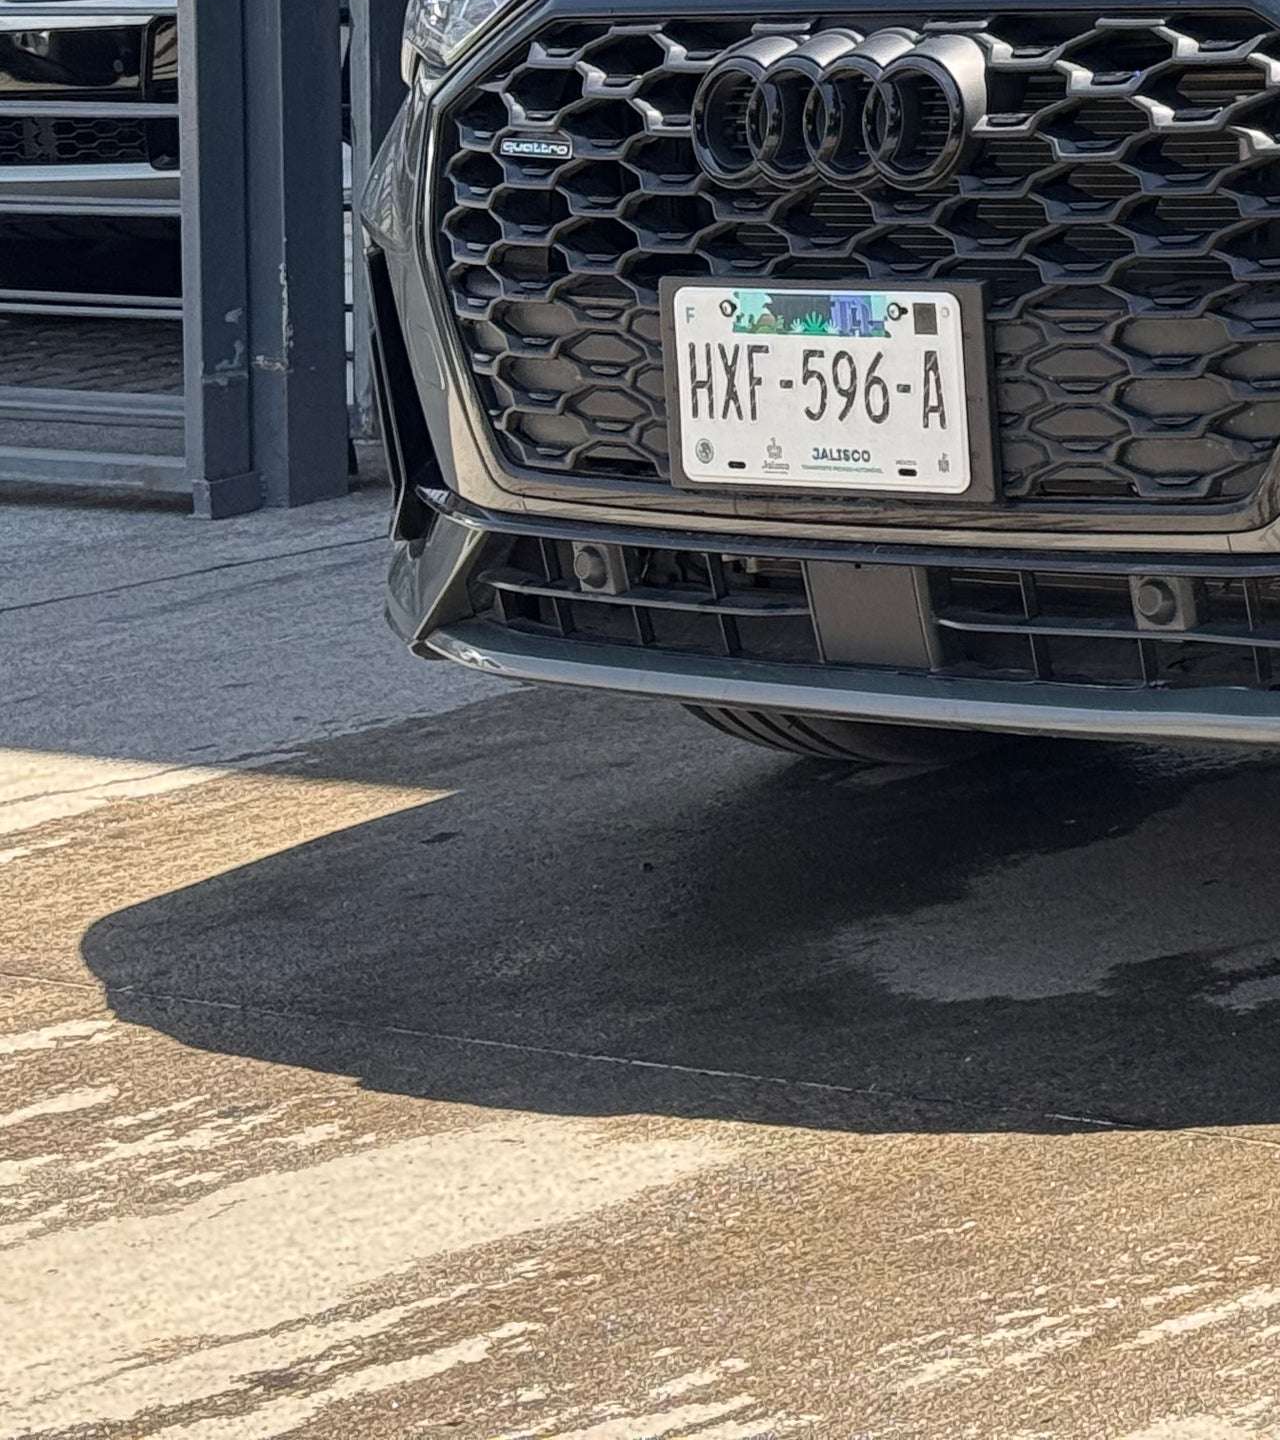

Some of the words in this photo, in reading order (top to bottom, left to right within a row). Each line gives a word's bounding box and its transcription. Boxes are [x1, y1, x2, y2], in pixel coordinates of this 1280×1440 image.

[502, 141, 568, 155] quattro
[688, 342, 947, 430] HXF-596-A
[811, 446, 872, 463] JALISCO
